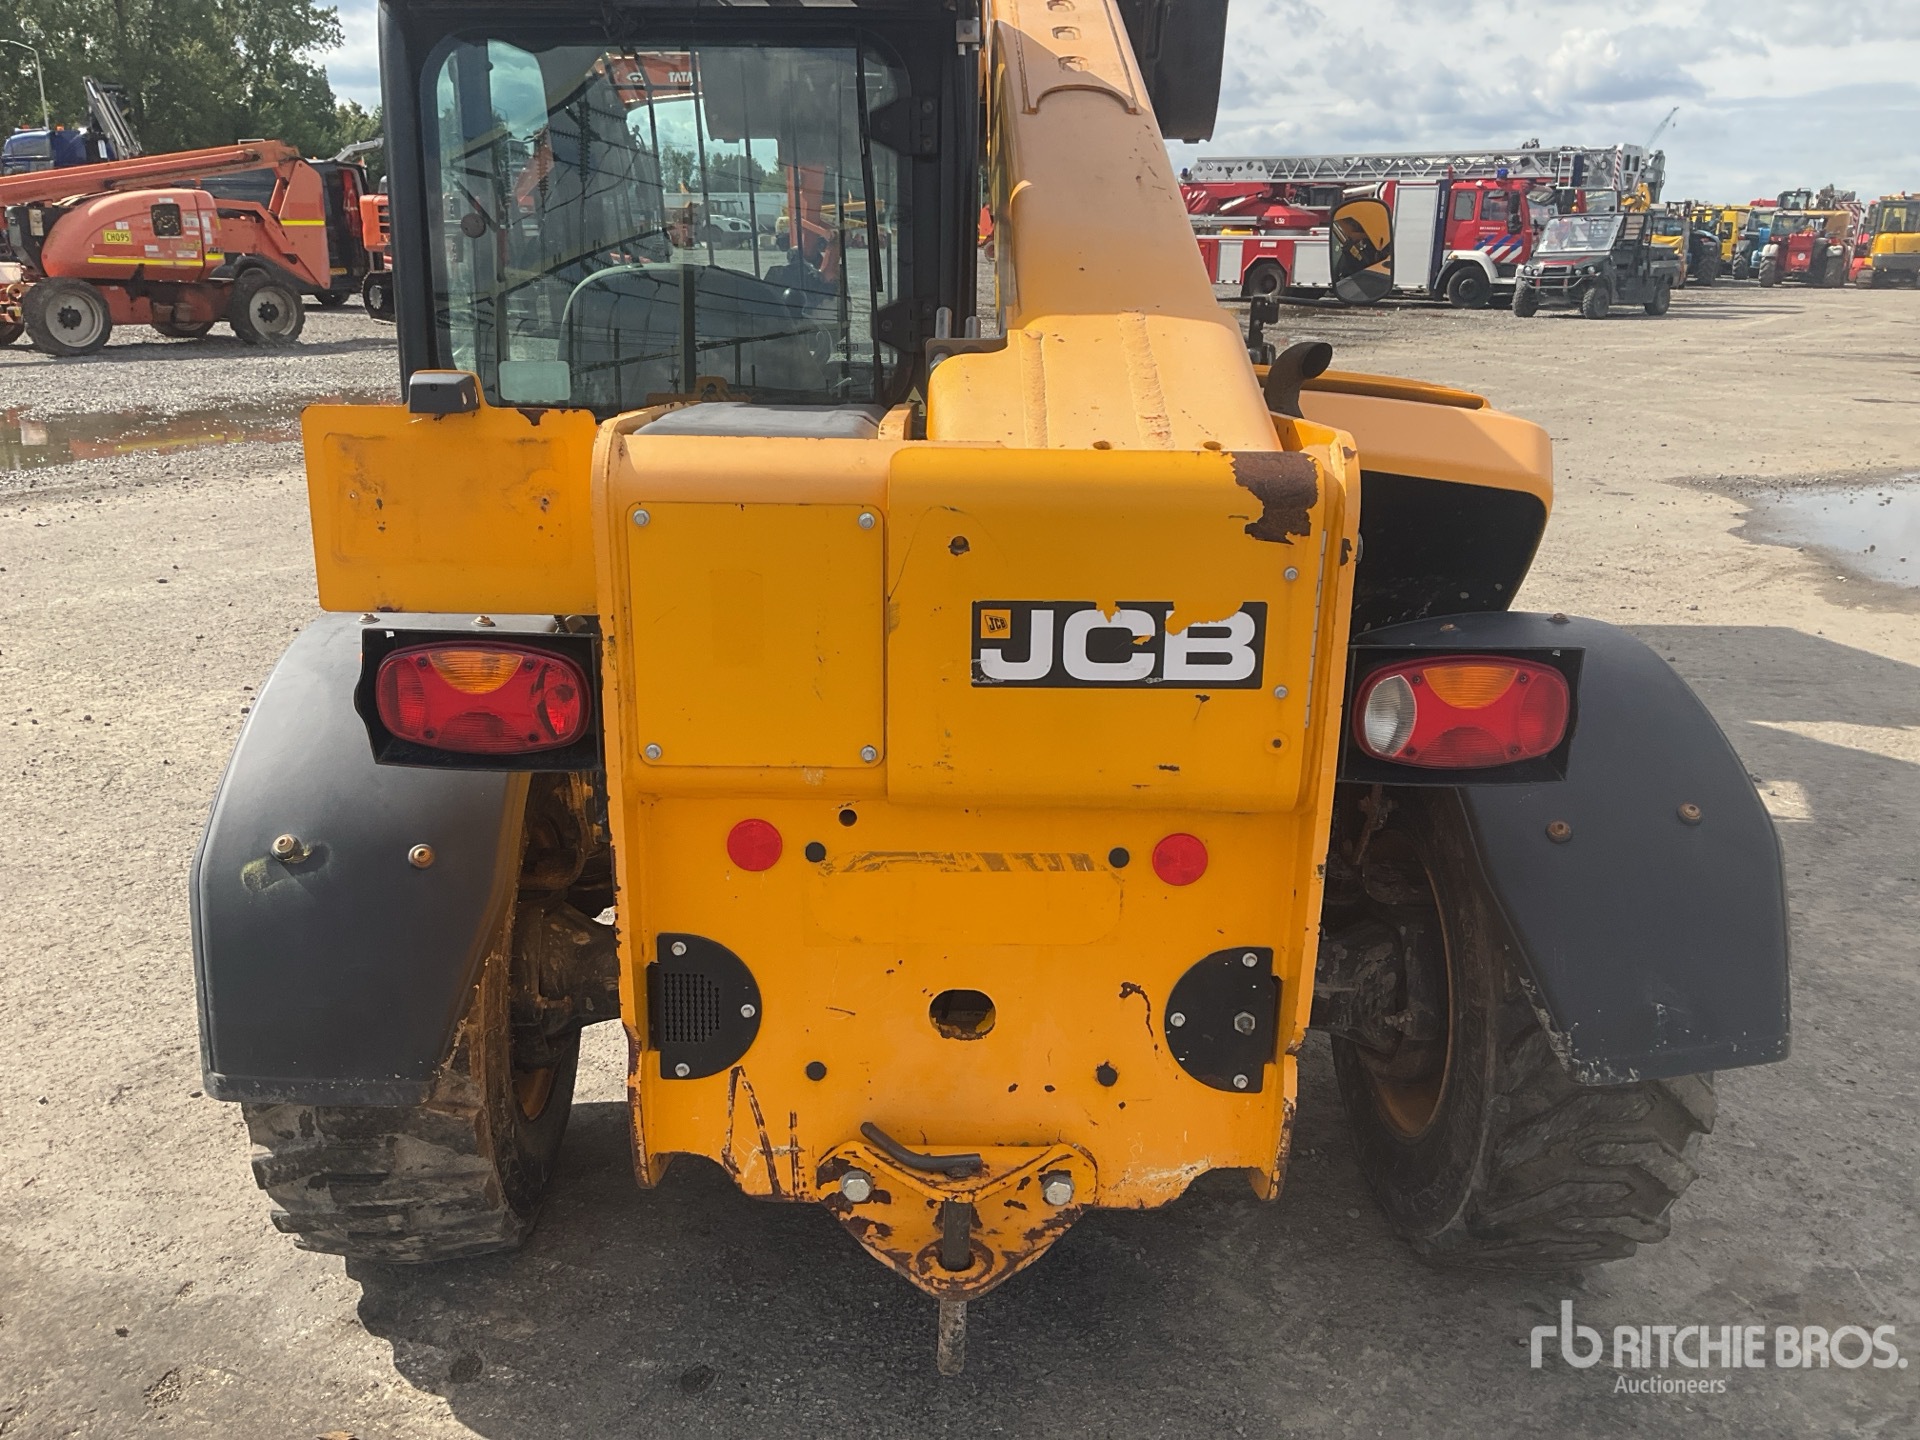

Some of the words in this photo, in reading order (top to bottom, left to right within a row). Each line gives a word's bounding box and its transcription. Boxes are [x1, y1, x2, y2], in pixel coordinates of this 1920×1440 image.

[668, 71, 693, 83] TATA
[989, 616, 1007, 631] JCB
[980, 609, 1256, 681] JCB
